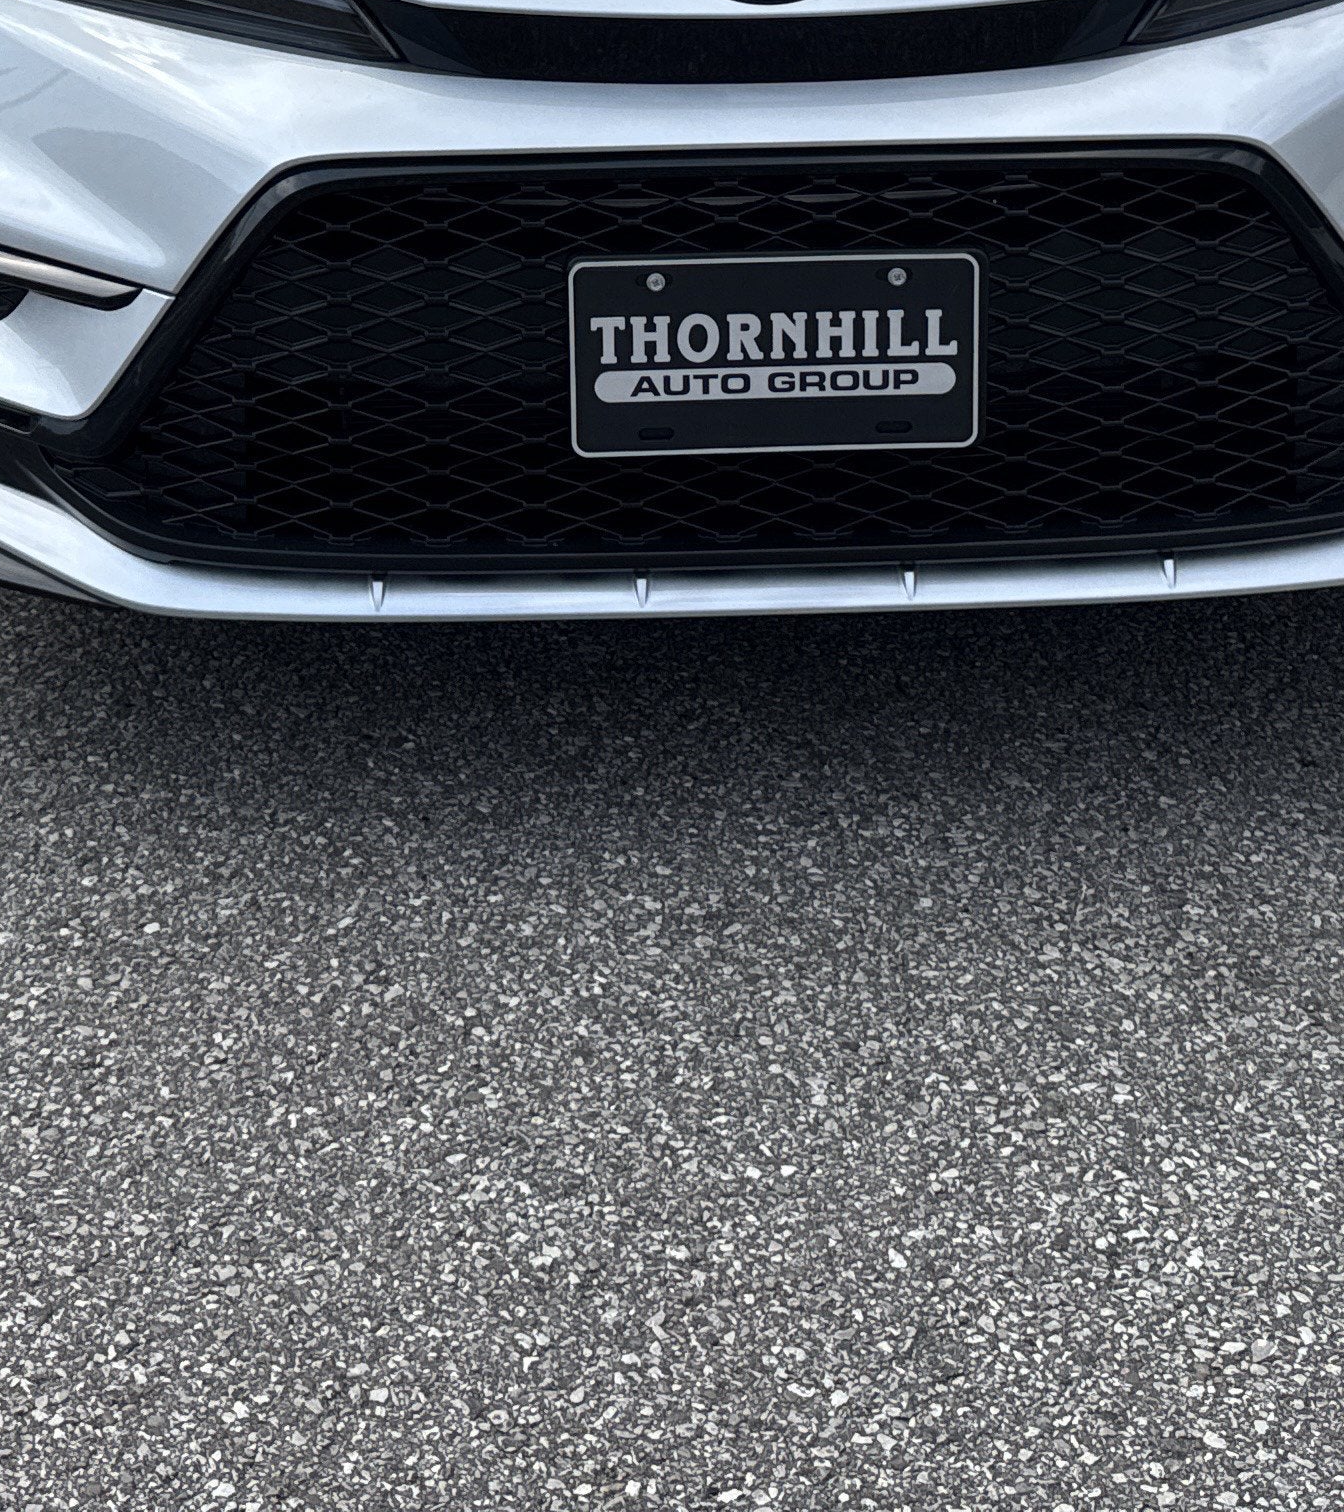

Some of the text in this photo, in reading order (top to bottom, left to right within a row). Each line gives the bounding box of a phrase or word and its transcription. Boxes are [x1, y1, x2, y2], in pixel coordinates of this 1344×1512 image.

[590, 308, 958, 365] THORNHILL
[630, 368, 920, 397] AUTO GROUP
